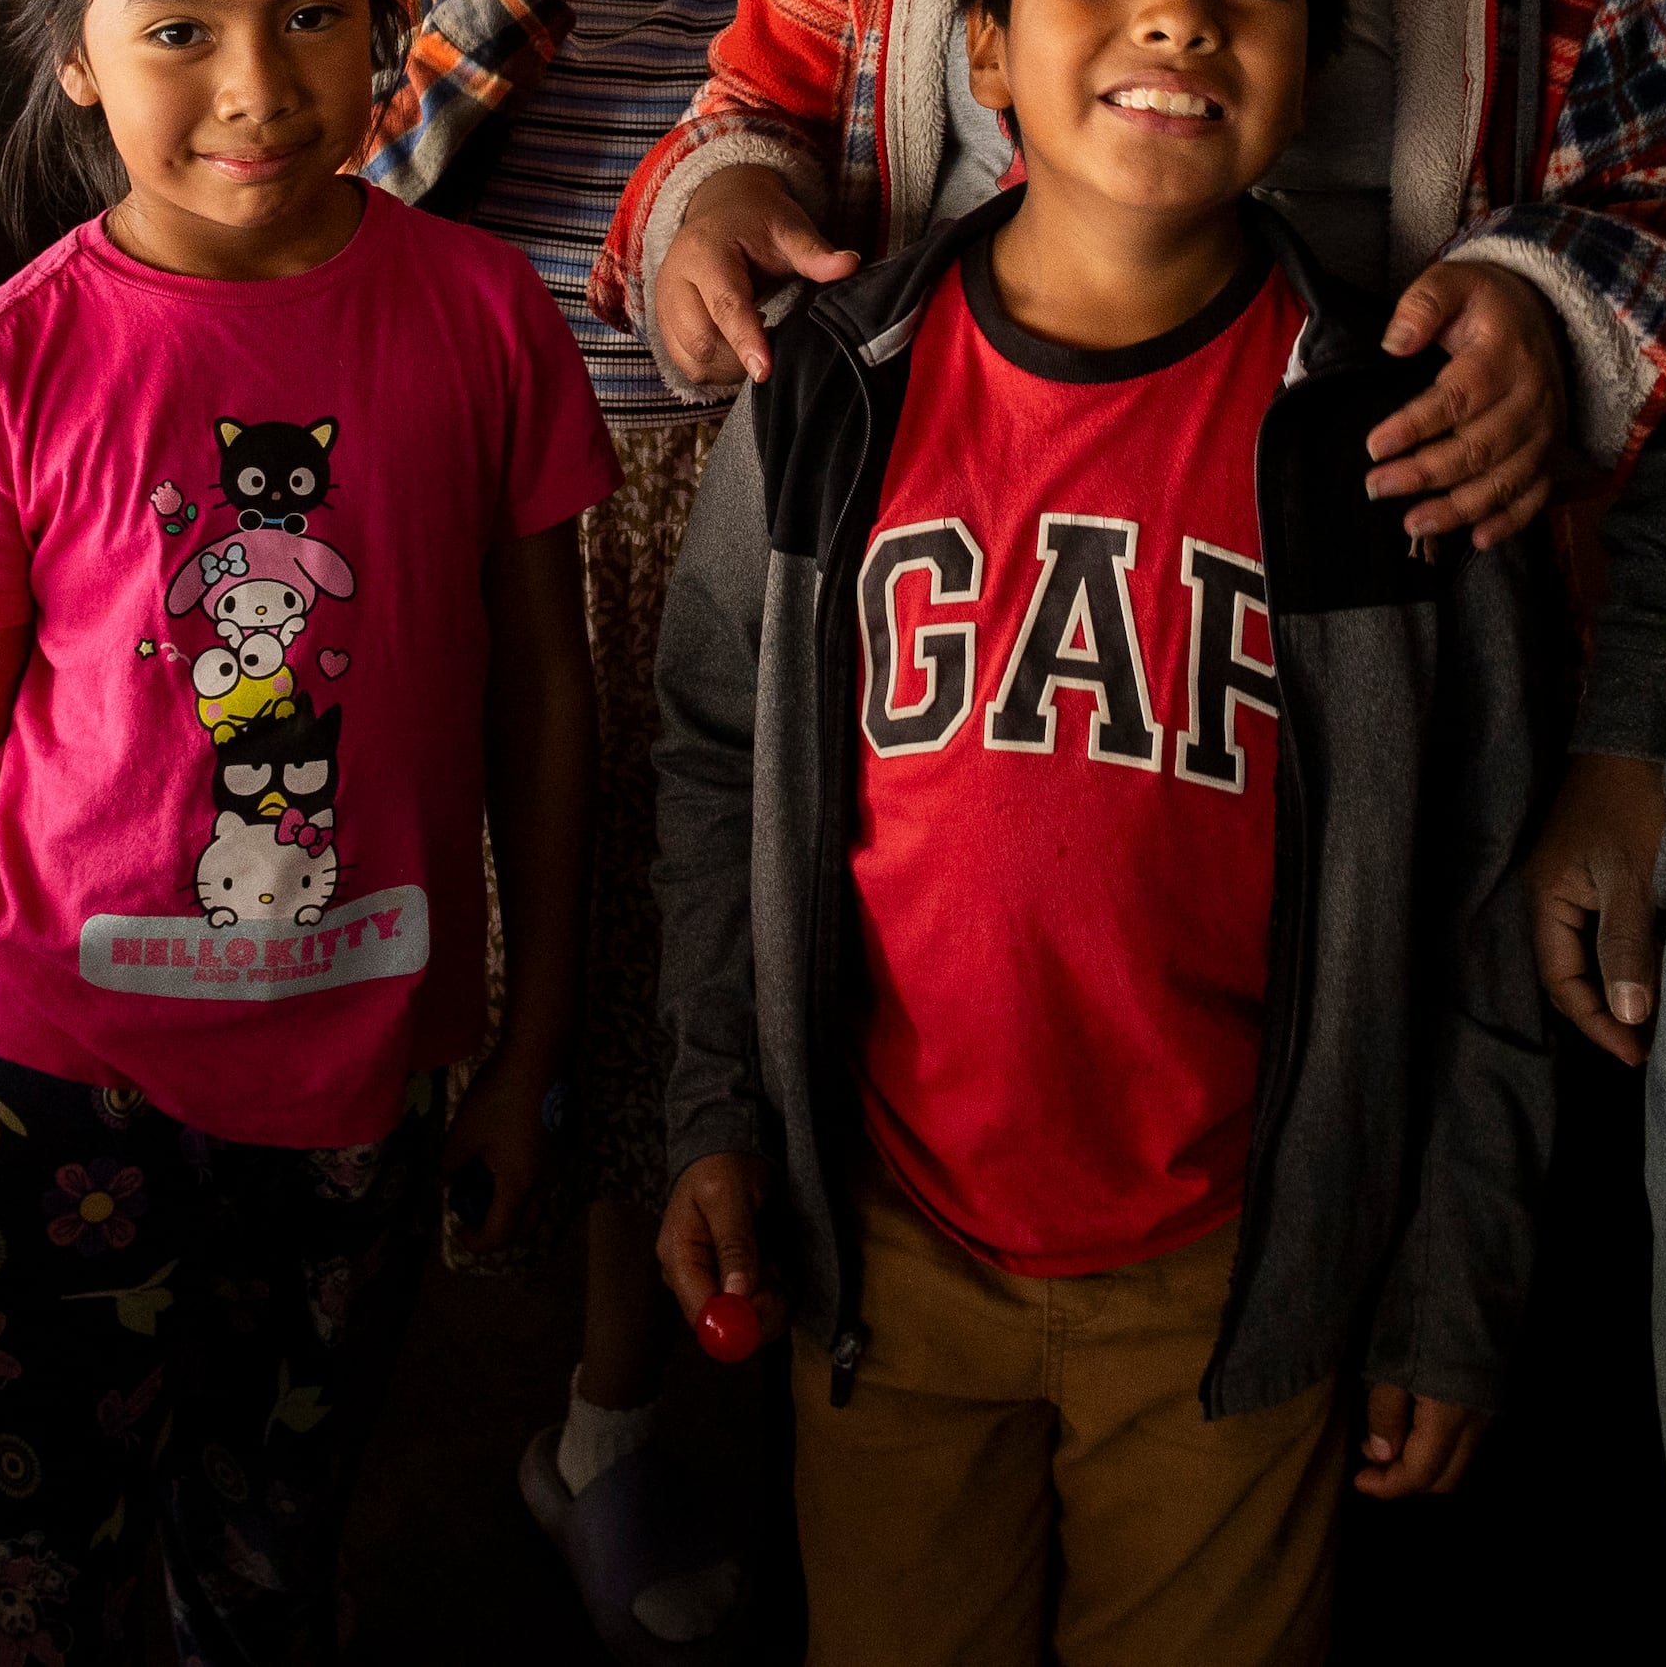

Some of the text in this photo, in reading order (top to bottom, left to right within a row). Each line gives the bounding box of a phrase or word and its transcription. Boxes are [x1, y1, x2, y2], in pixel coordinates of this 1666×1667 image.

[111, 906, 403, 968] HELLO KITTY
[191, 960, 332, 984] AND FRIENDS
